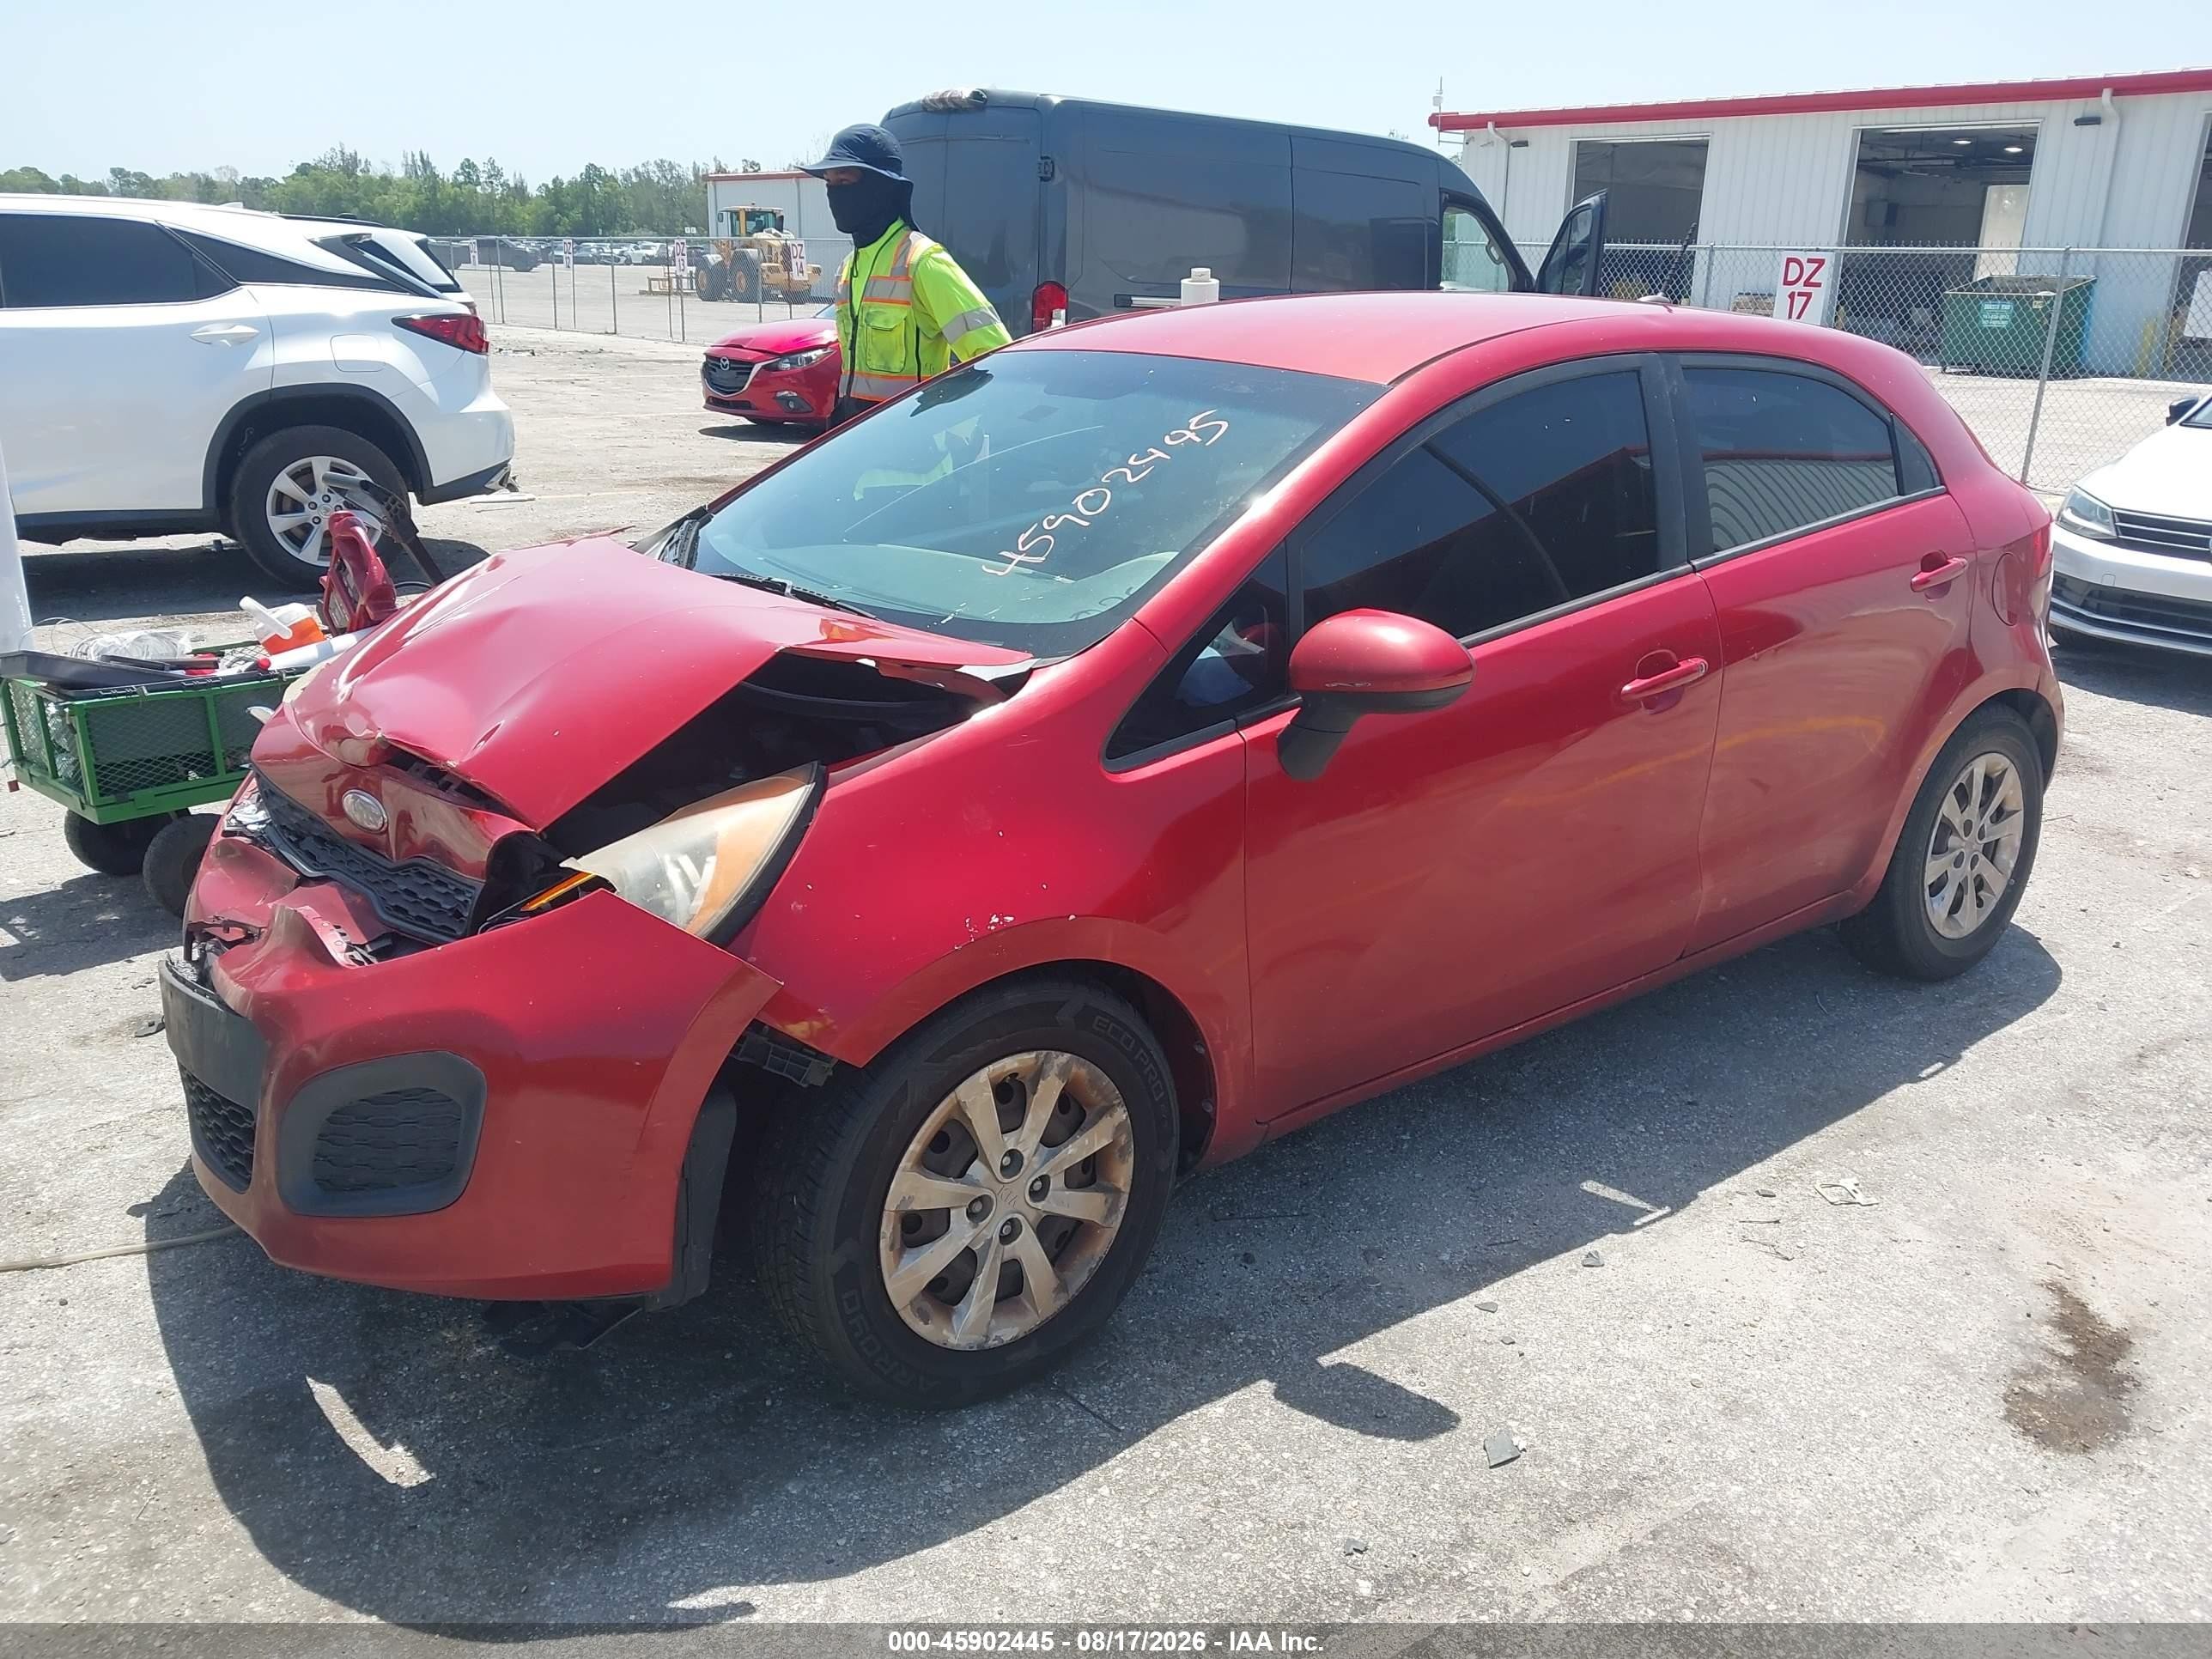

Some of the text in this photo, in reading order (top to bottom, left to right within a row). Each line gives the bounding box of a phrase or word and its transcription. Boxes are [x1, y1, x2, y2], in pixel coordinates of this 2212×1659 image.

[563, 241, 572, 255] DZ
[676, 242, 686, 256] DZ
[792, 243, 805, 259] DZ
[678, 258, 685, 271] 13
[795, 262, 805, 276] 14
[1783, 257, 1826, 288] DZ
[1787, 290, 1813, 320] 17
